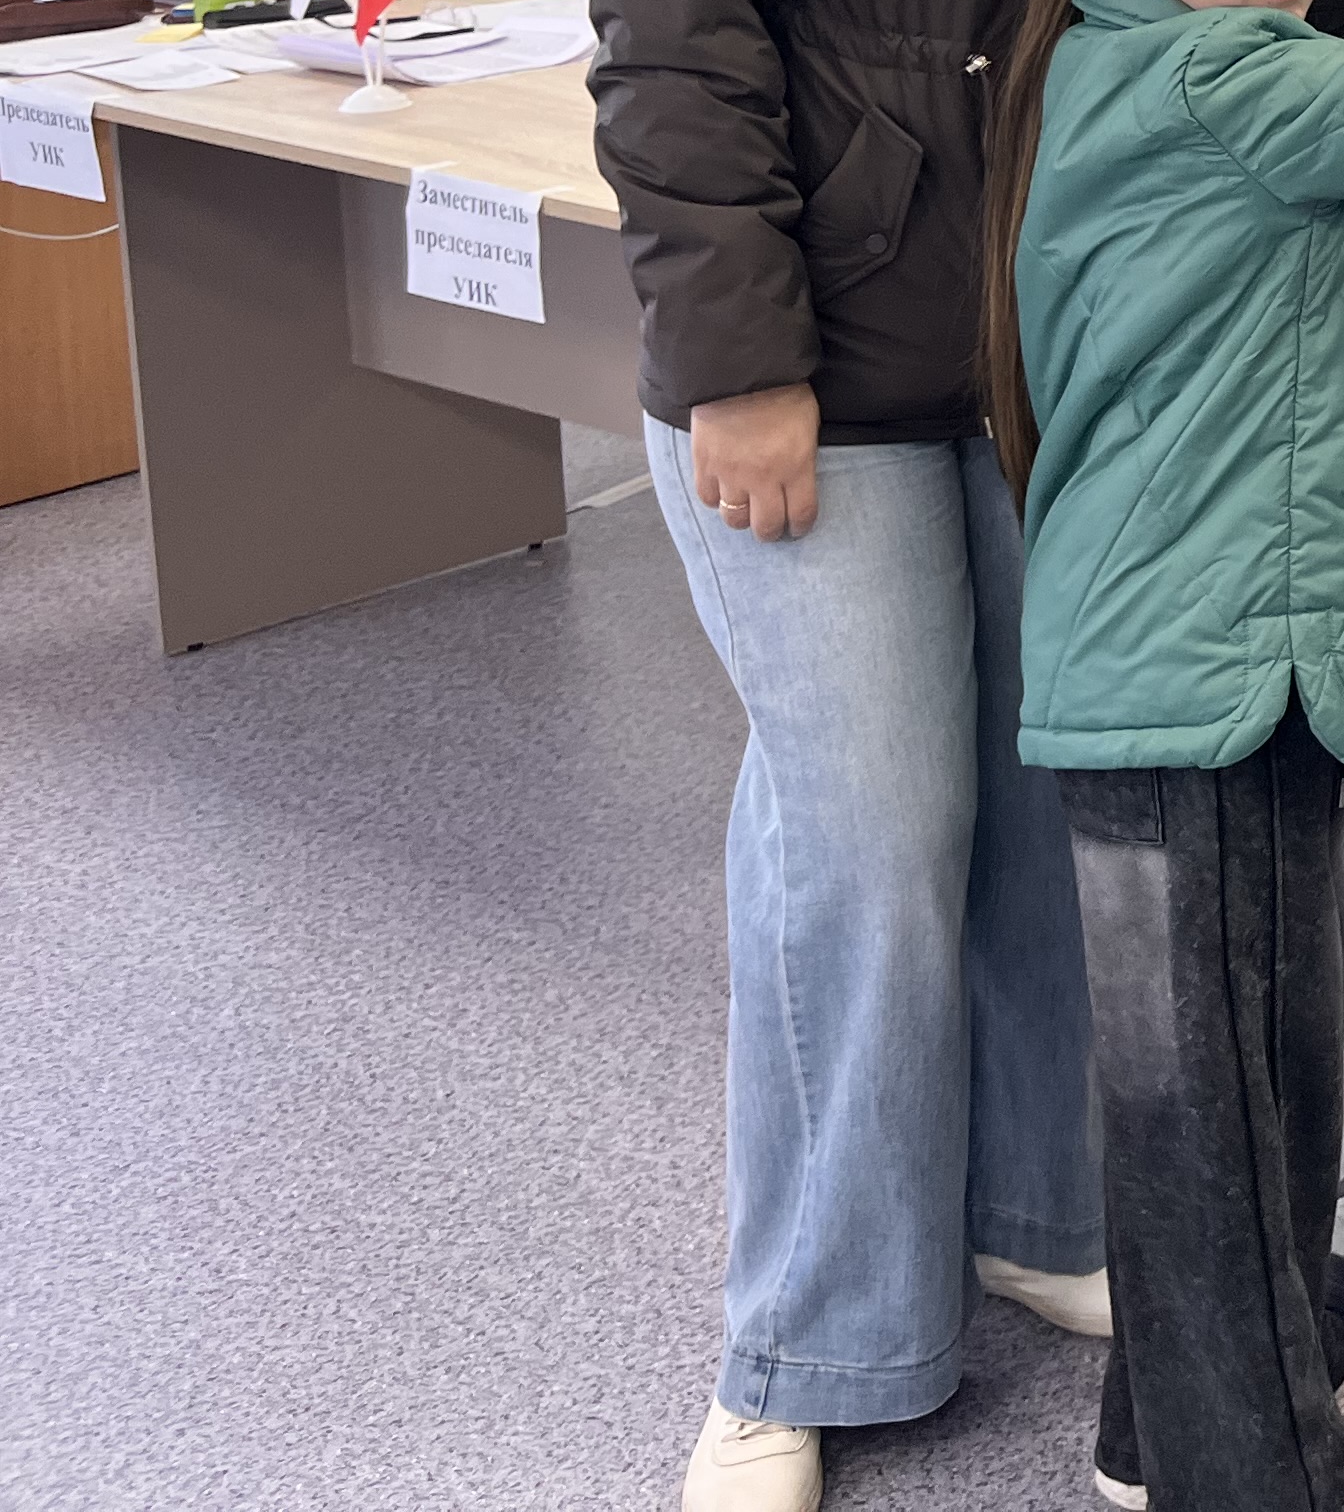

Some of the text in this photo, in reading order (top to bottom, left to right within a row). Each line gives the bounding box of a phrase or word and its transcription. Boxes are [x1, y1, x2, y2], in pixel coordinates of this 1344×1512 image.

[28, 141, 65, 168] УИК
[416, 179, 528, 225] Заместитель
[415, 228, 533, 269] председателя
[453, 275, 497, 307] УИК
